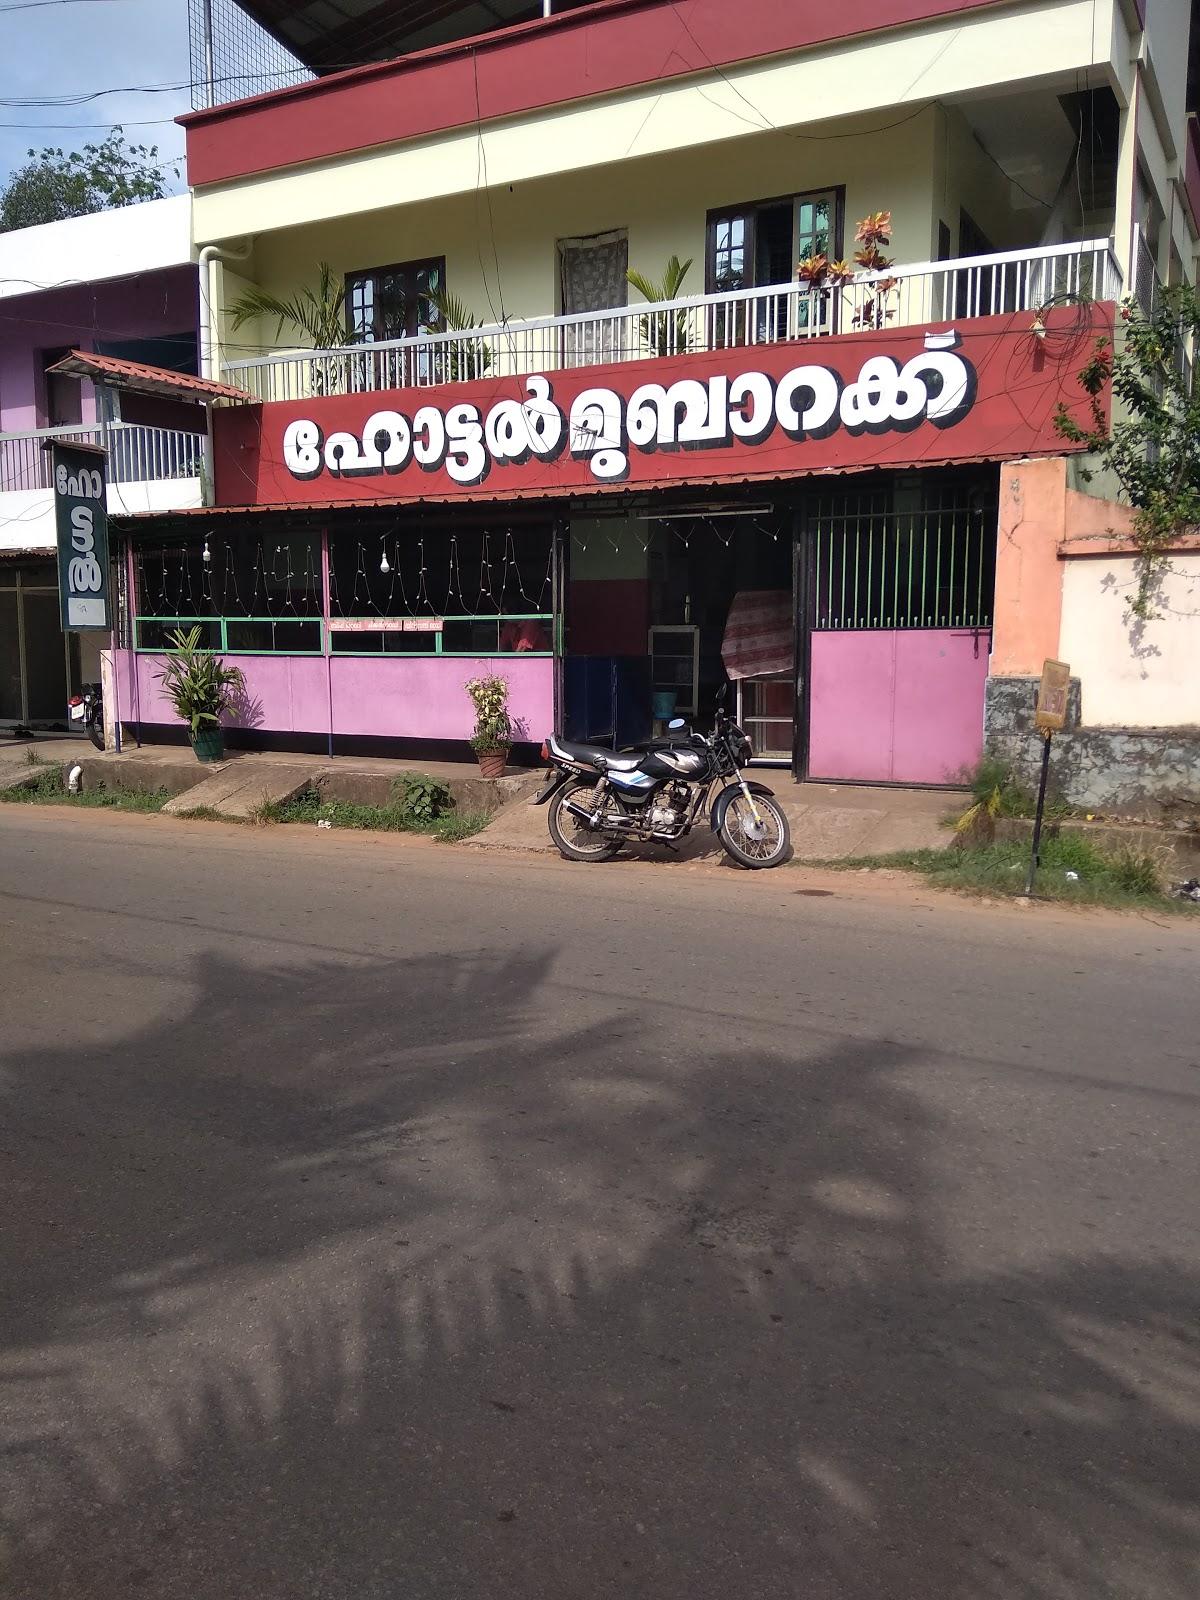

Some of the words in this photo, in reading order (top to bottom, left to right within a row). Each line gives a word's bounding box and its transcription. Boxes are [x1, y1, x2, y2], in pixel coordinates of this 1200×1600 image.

[283, 375, 562, 482] ഹോട്ടൽ
[569, 328, 968, 478] മുബാറക്ക്
[561, 762, 582, 774] SPEED
